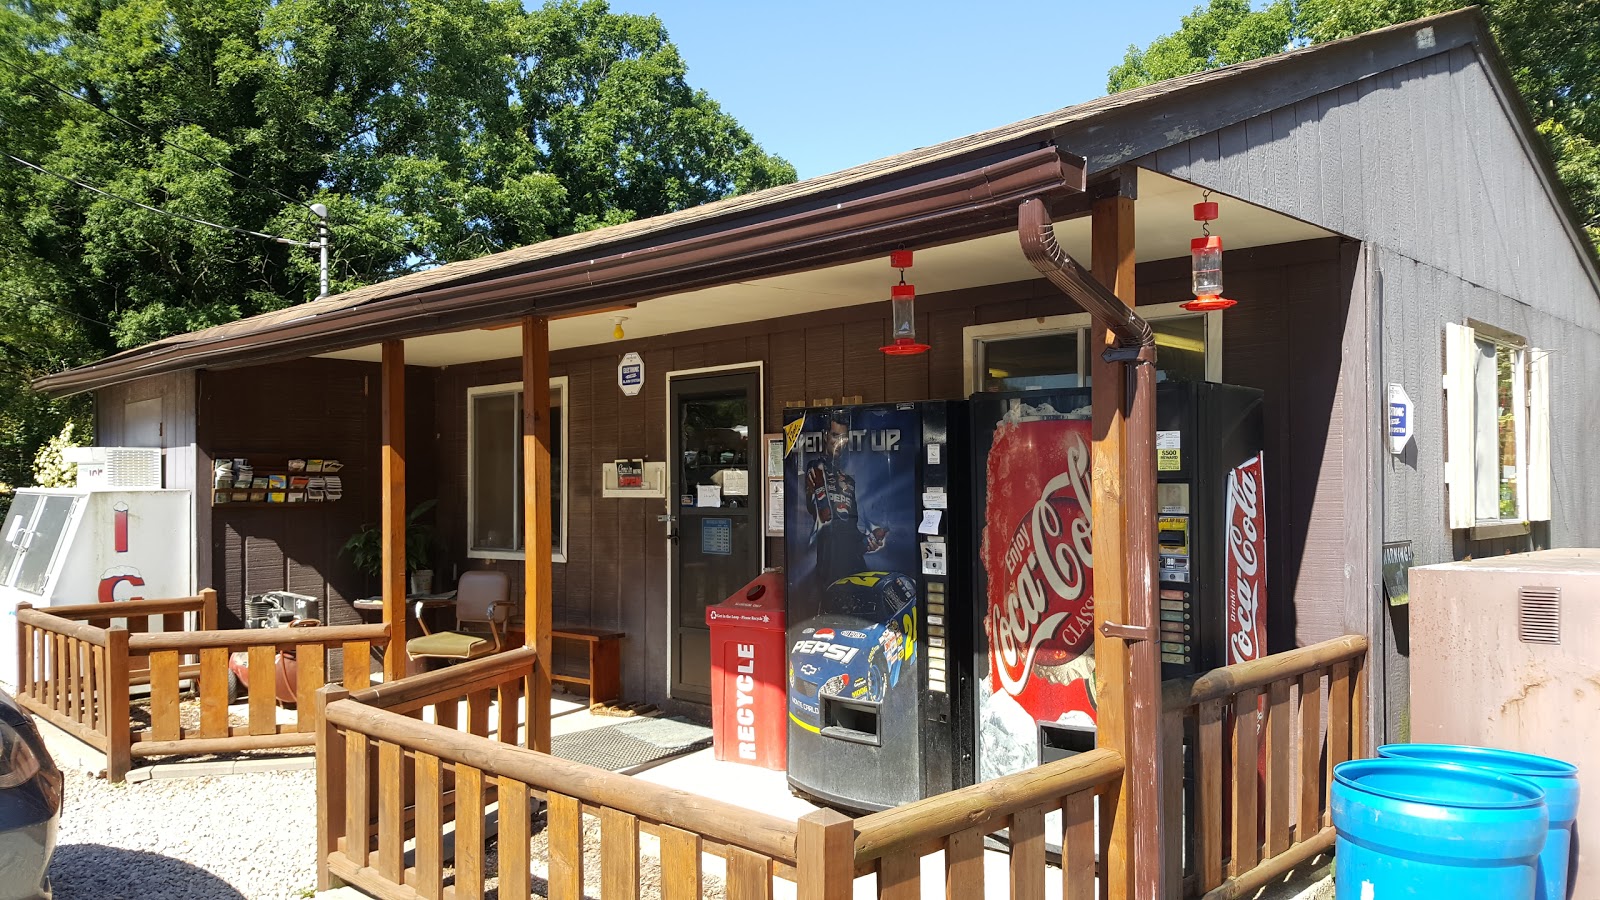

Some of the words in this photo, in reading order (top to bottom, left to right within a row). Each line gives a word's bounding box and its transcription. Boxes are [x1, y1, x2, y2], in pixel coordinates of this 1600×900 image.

[849, 429, 867, 452] IT
[871, 429, 901, 451] UP.
[992, 432, 1093, 696] Coca-Col
[1006, 524, 1031, 576] Enjoy
[1062, 595, 1094, 646] CLASS
[791, 641, 860, 664] PEPSI
[736, 643, 757, 760] RECYCLE
